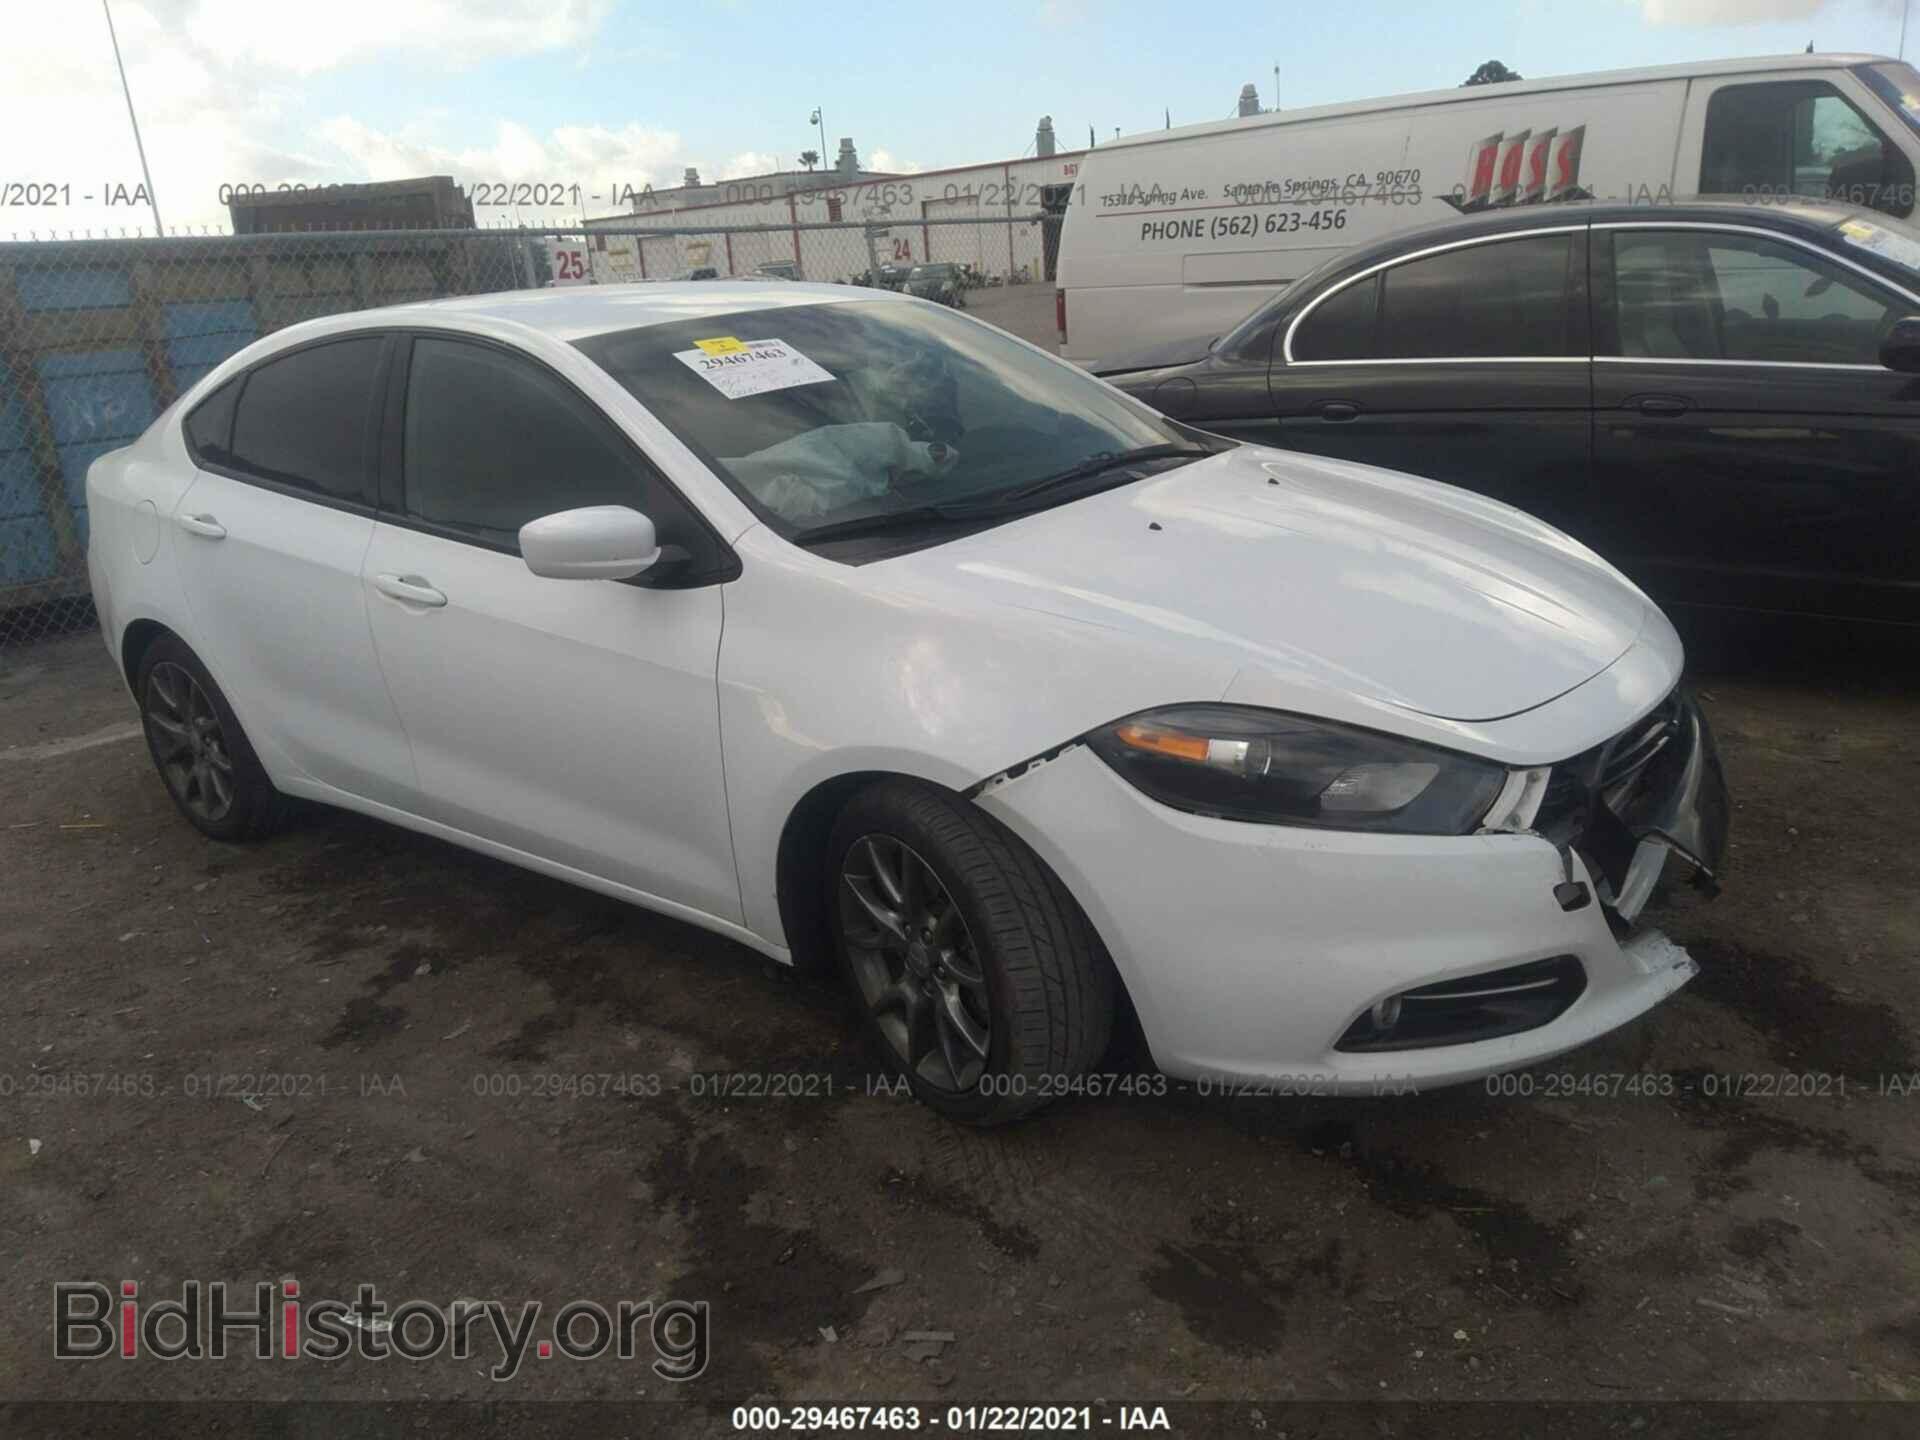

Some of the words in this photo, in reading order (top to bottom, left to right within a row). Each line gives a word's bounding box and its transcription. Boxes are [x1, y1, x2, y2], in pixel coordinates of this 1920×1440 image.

[1180, 187, 1208, 201] Ave.
[1376, 168, 1421, 186] 90670
[1140, 217, 1204, 241] PHONE
[1210, 212, 1259, 240] (562)
[1264, 208, 1346, 234] 623-456
[893, 238, 911, 260] 24
[556, 250, 584, 280] 25
[699, 347, 787, 370] 29467463
